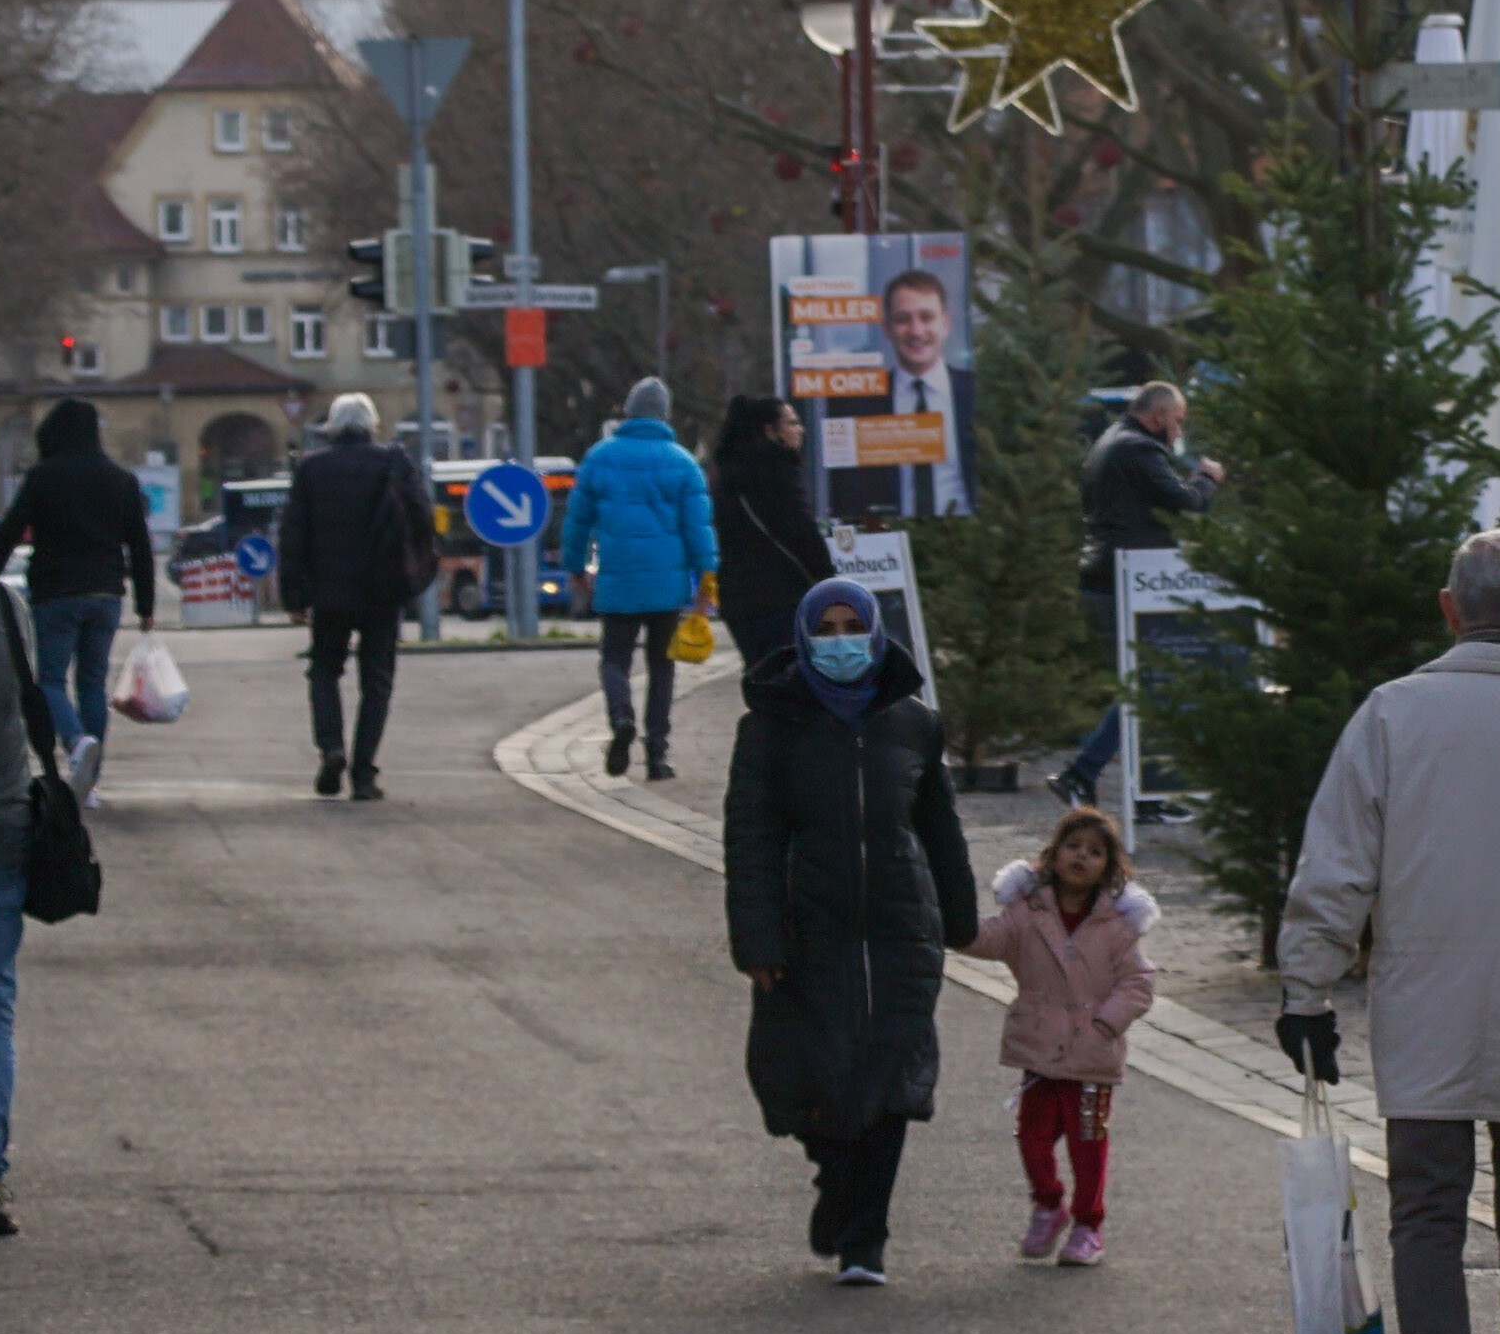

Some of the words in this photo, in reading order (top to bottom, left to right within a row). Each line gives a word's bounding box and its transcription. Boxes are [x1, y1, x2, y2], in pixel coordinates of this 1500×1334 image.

[792, 299, 876, 319] MILLER
[795, 373, 822, 394] IM
[830, 372, 885, 394] ORT.
[835, 552, 899, 575] önbuch
